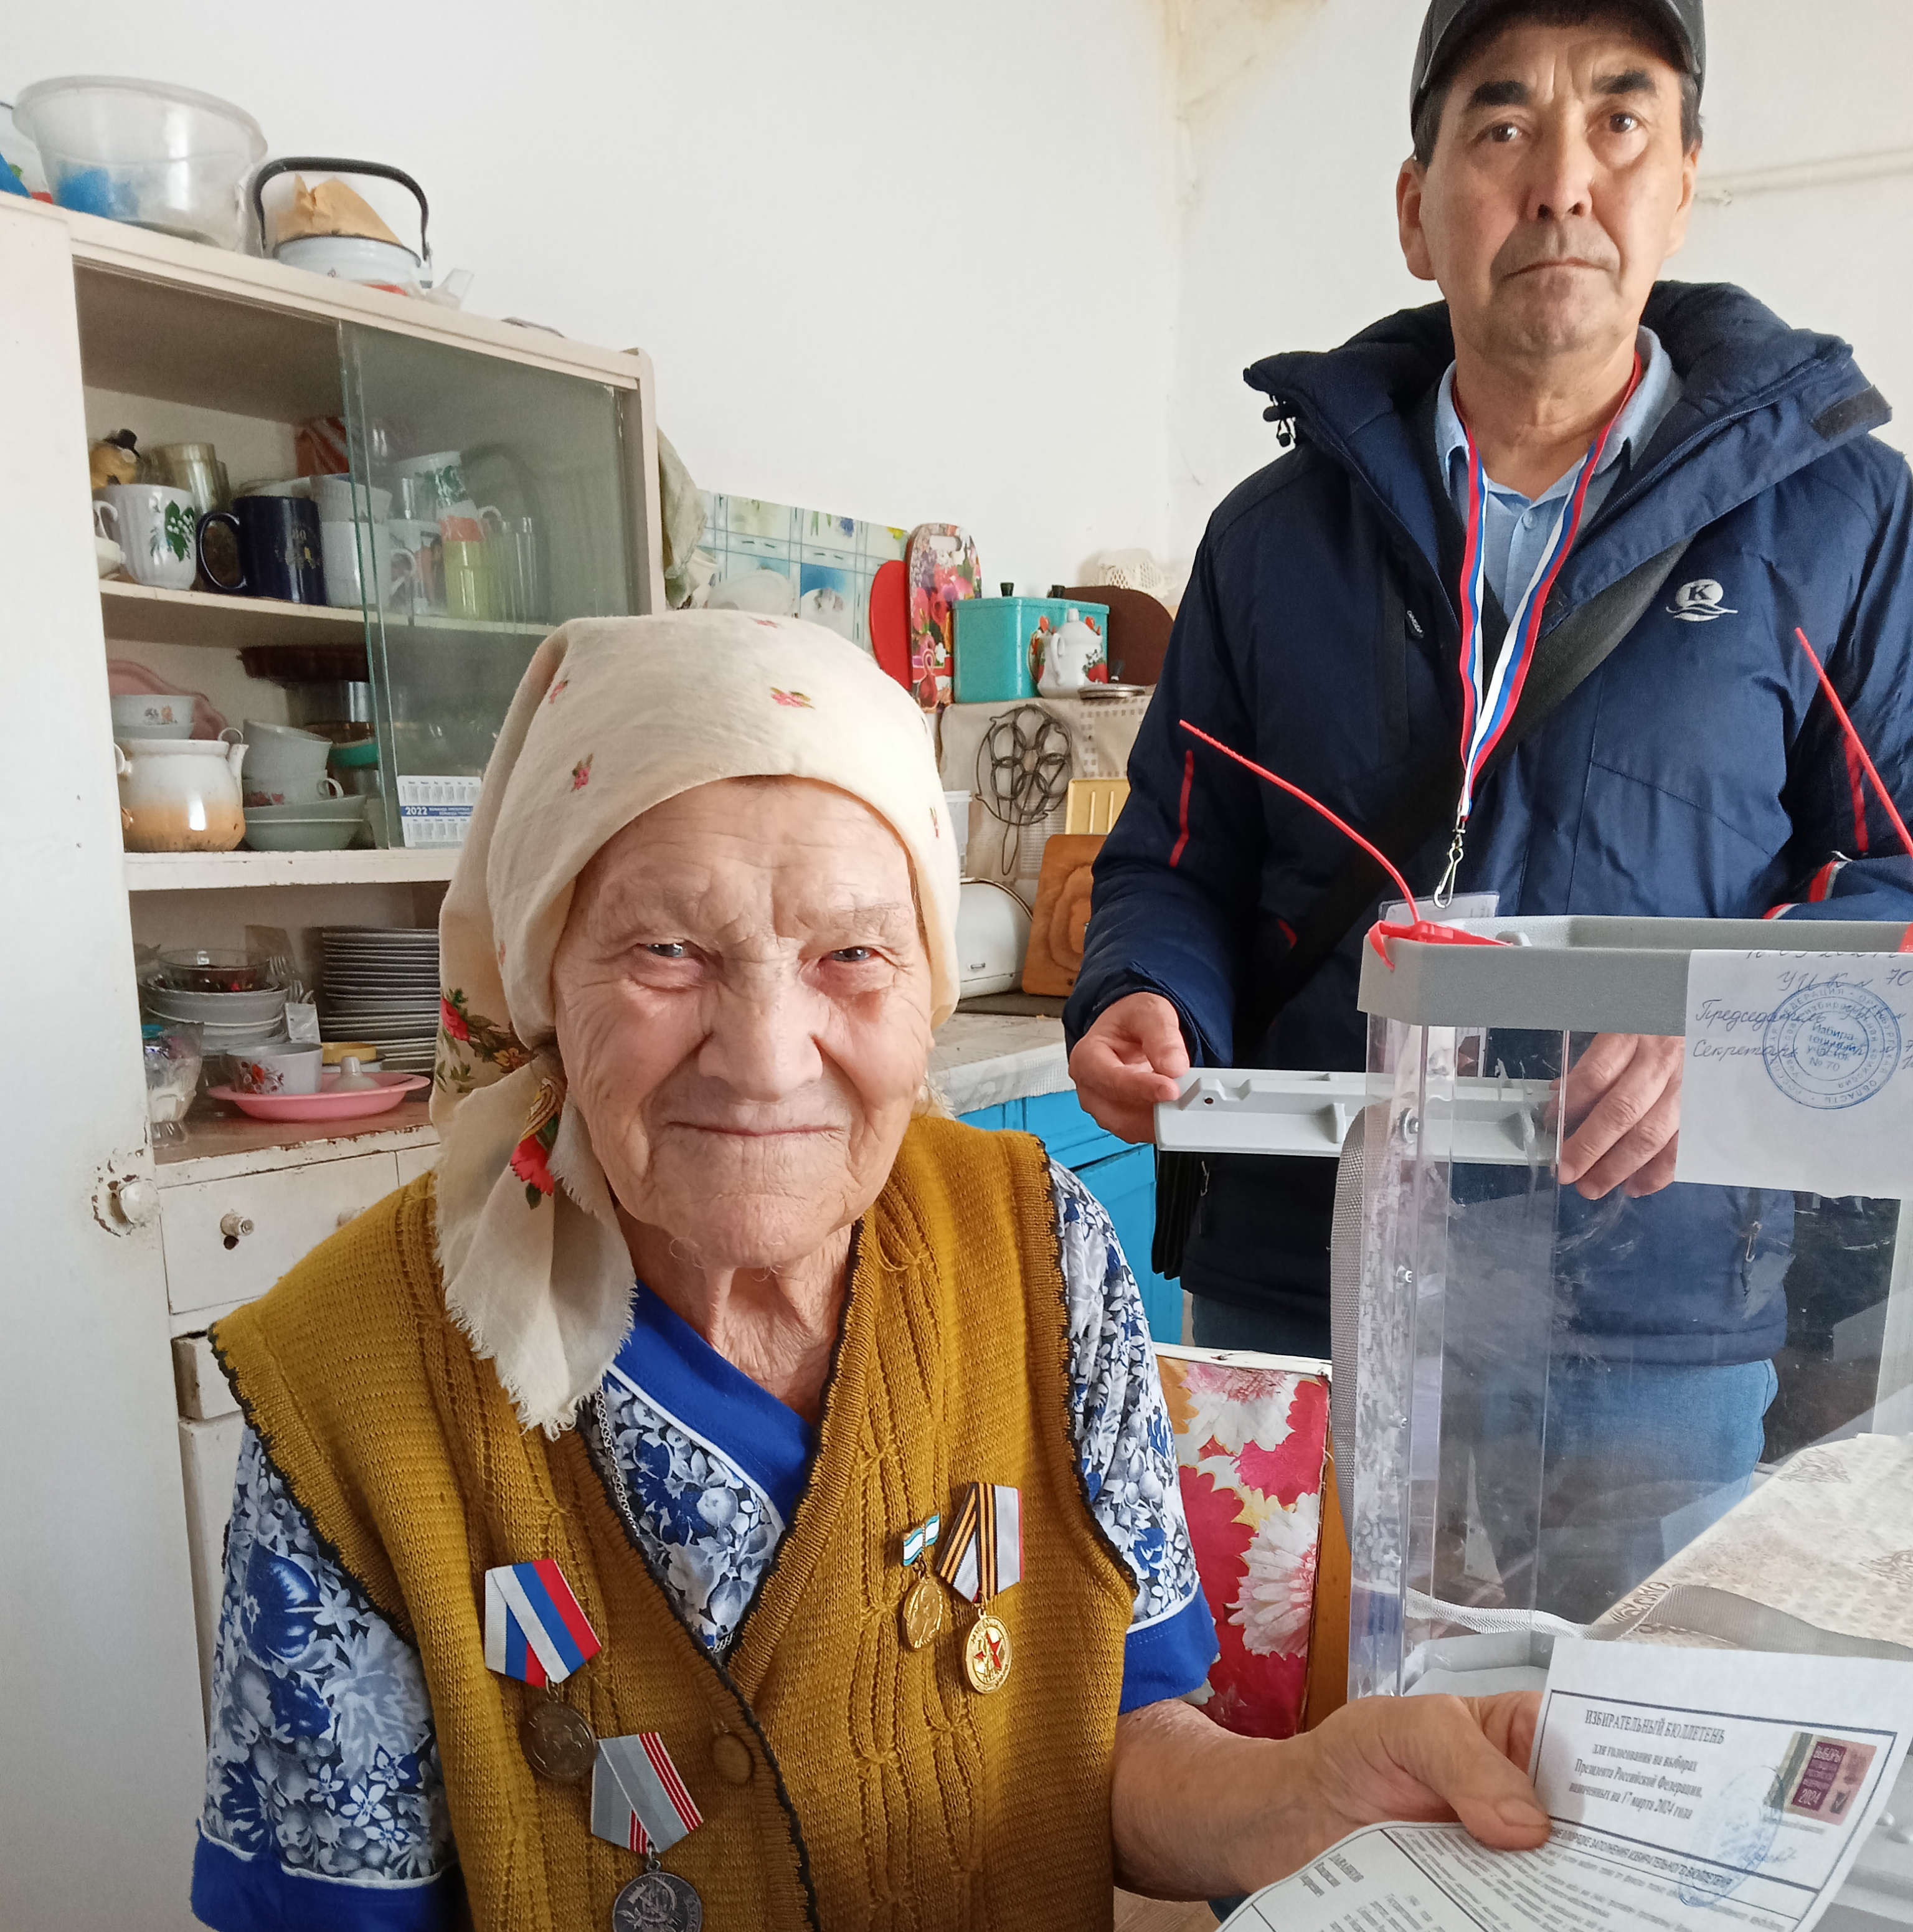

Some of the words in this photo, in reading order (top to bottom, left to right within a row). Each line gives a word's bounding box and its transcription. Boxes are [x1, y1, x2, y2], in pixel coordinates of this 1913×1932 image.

[405, 807, 428, 815] 2022
[1827, 1061, 1840, 1071] 70
[1585, 1709, 1665, 1736] ИЗБИРАТЕЛЬНЫЙ
[1664, 1721, 1725, 1745] БЮЛЛЕТЕНЬ
